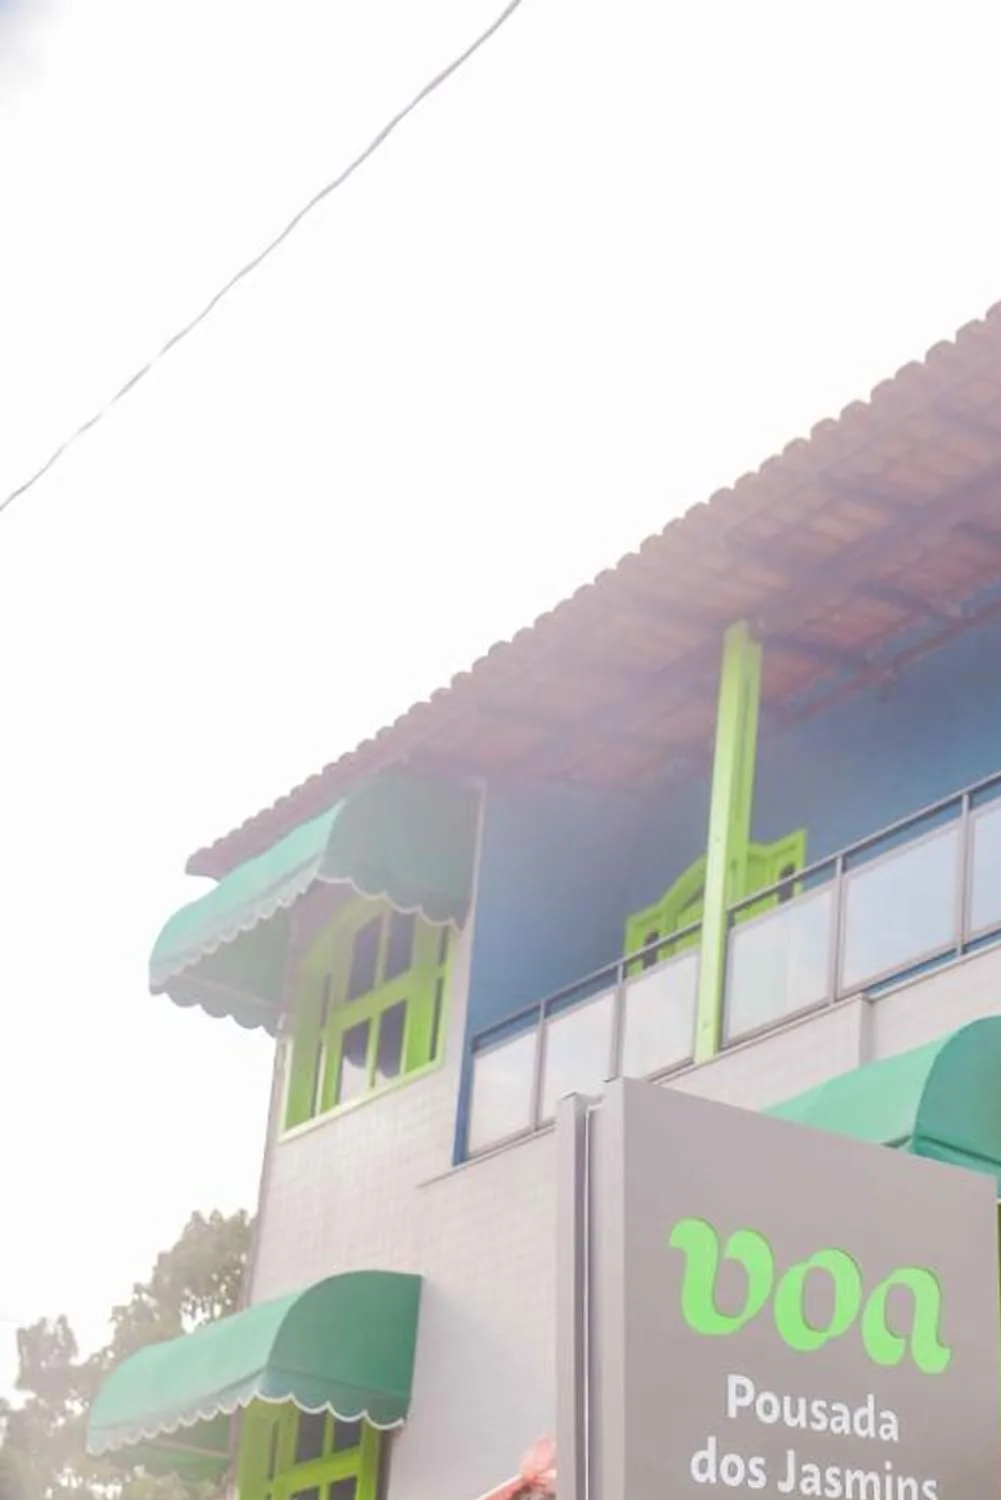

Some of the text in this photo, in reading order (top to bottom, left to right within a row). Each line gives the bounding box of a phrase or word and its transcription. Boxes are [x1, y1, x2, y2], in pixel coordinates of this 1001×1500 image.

[669, 1217, 952, 1375] voa
[726, 1374, 900, 1442] Pousada
[690, 1436, 767, 1489] dos
